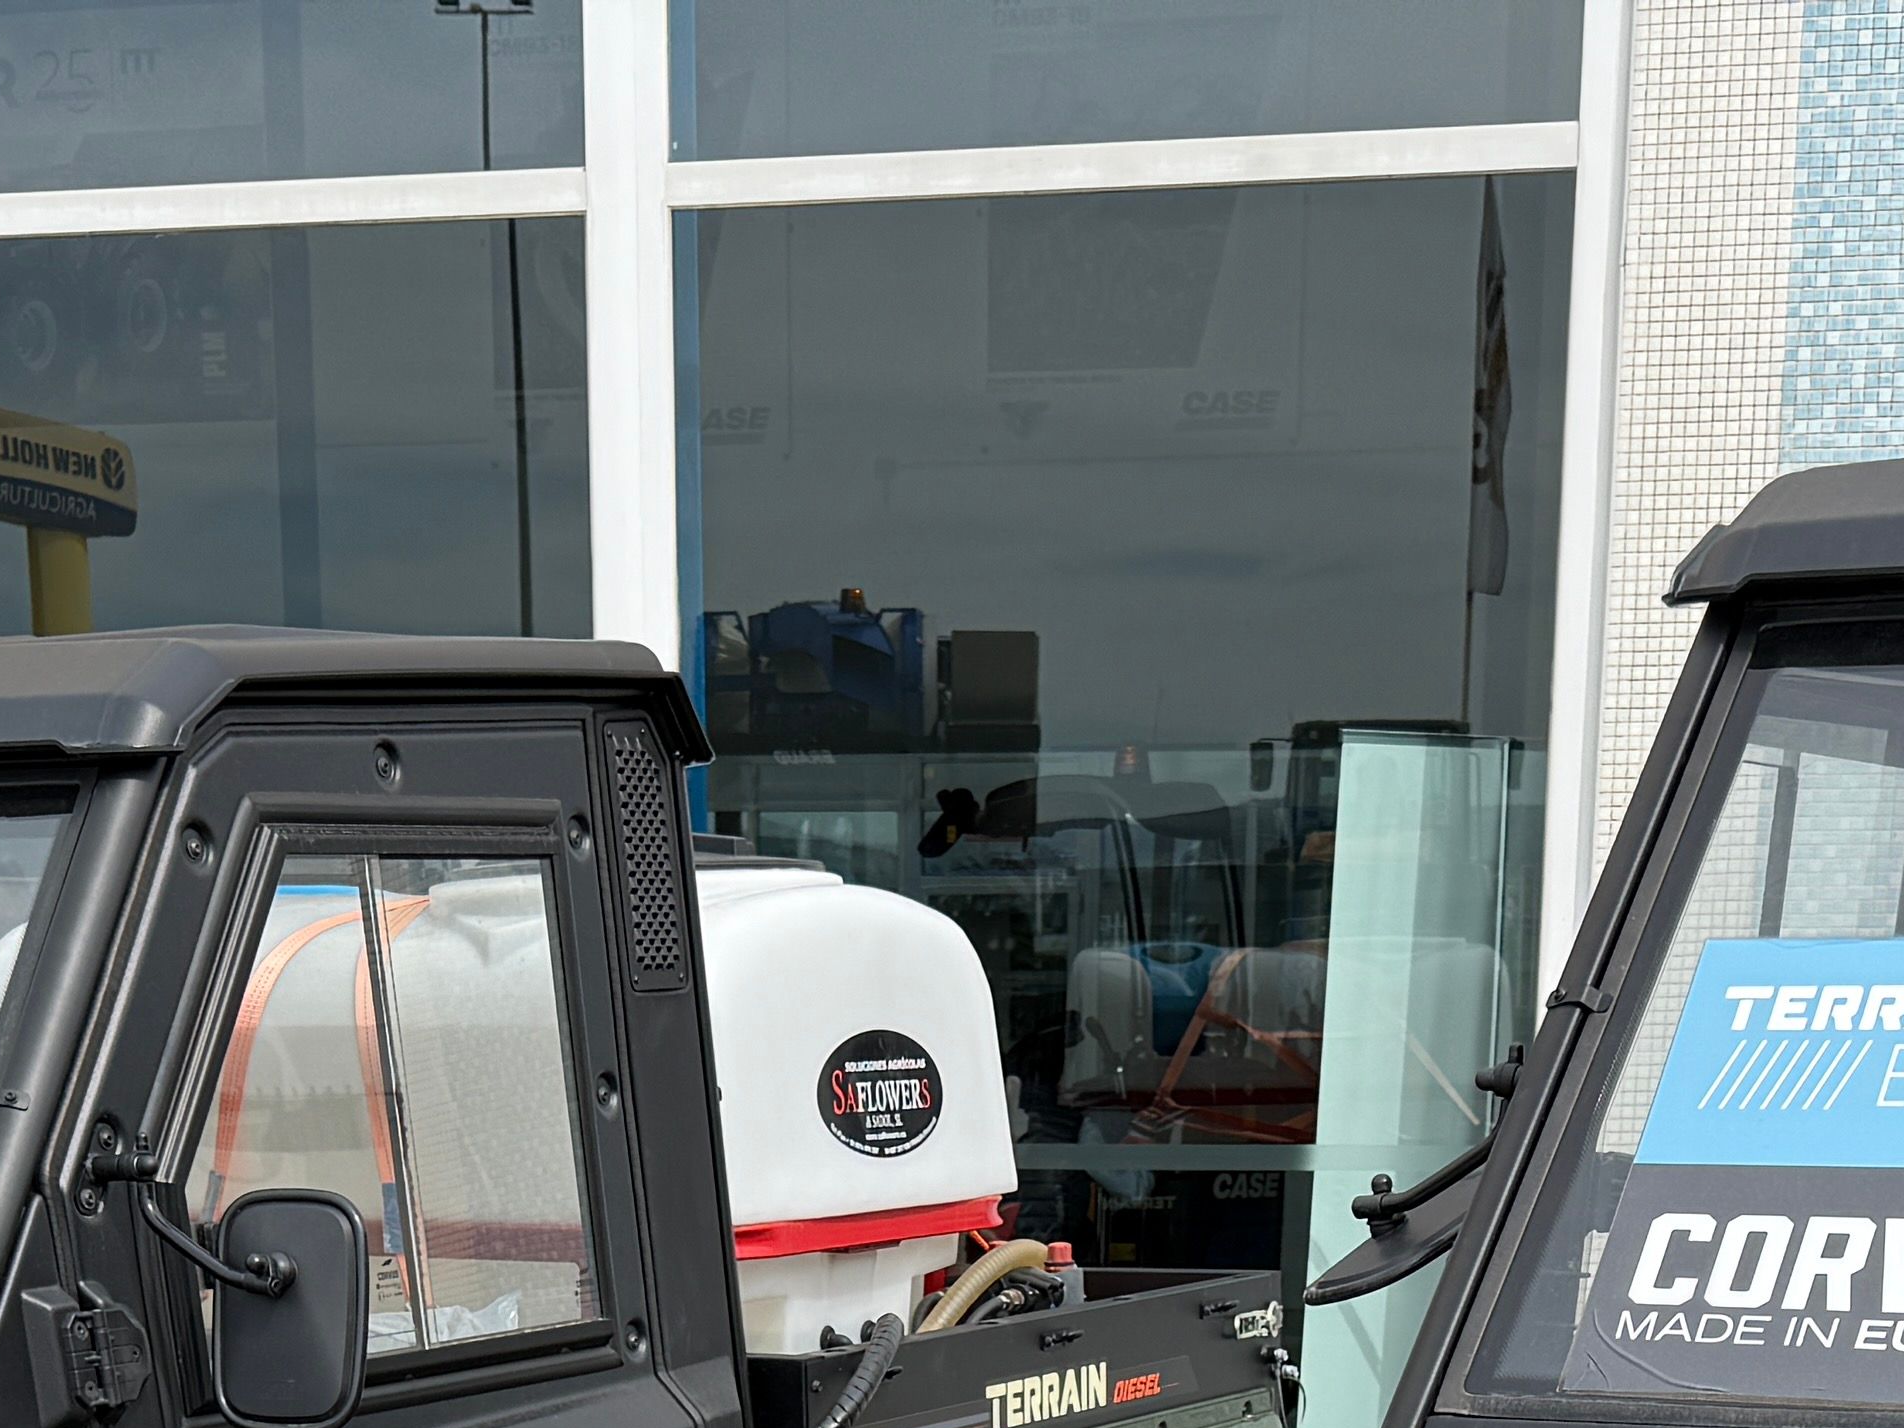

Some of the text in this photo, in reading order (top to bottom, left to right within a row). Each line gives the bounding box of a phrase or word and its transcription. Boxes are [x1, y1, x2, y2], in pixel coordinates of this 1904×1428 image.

[700, 406, 771, 432] ASE
[831, 1070, 931, 1116] SAFLOWERS
[1212, 1173, 1282, 1200] CASE
[1614, 1309, 1770, 1347] MADE
[1784, 1316, 1840, 1349] IN
[1113, 1372, 1162, 1405] DIESEL
